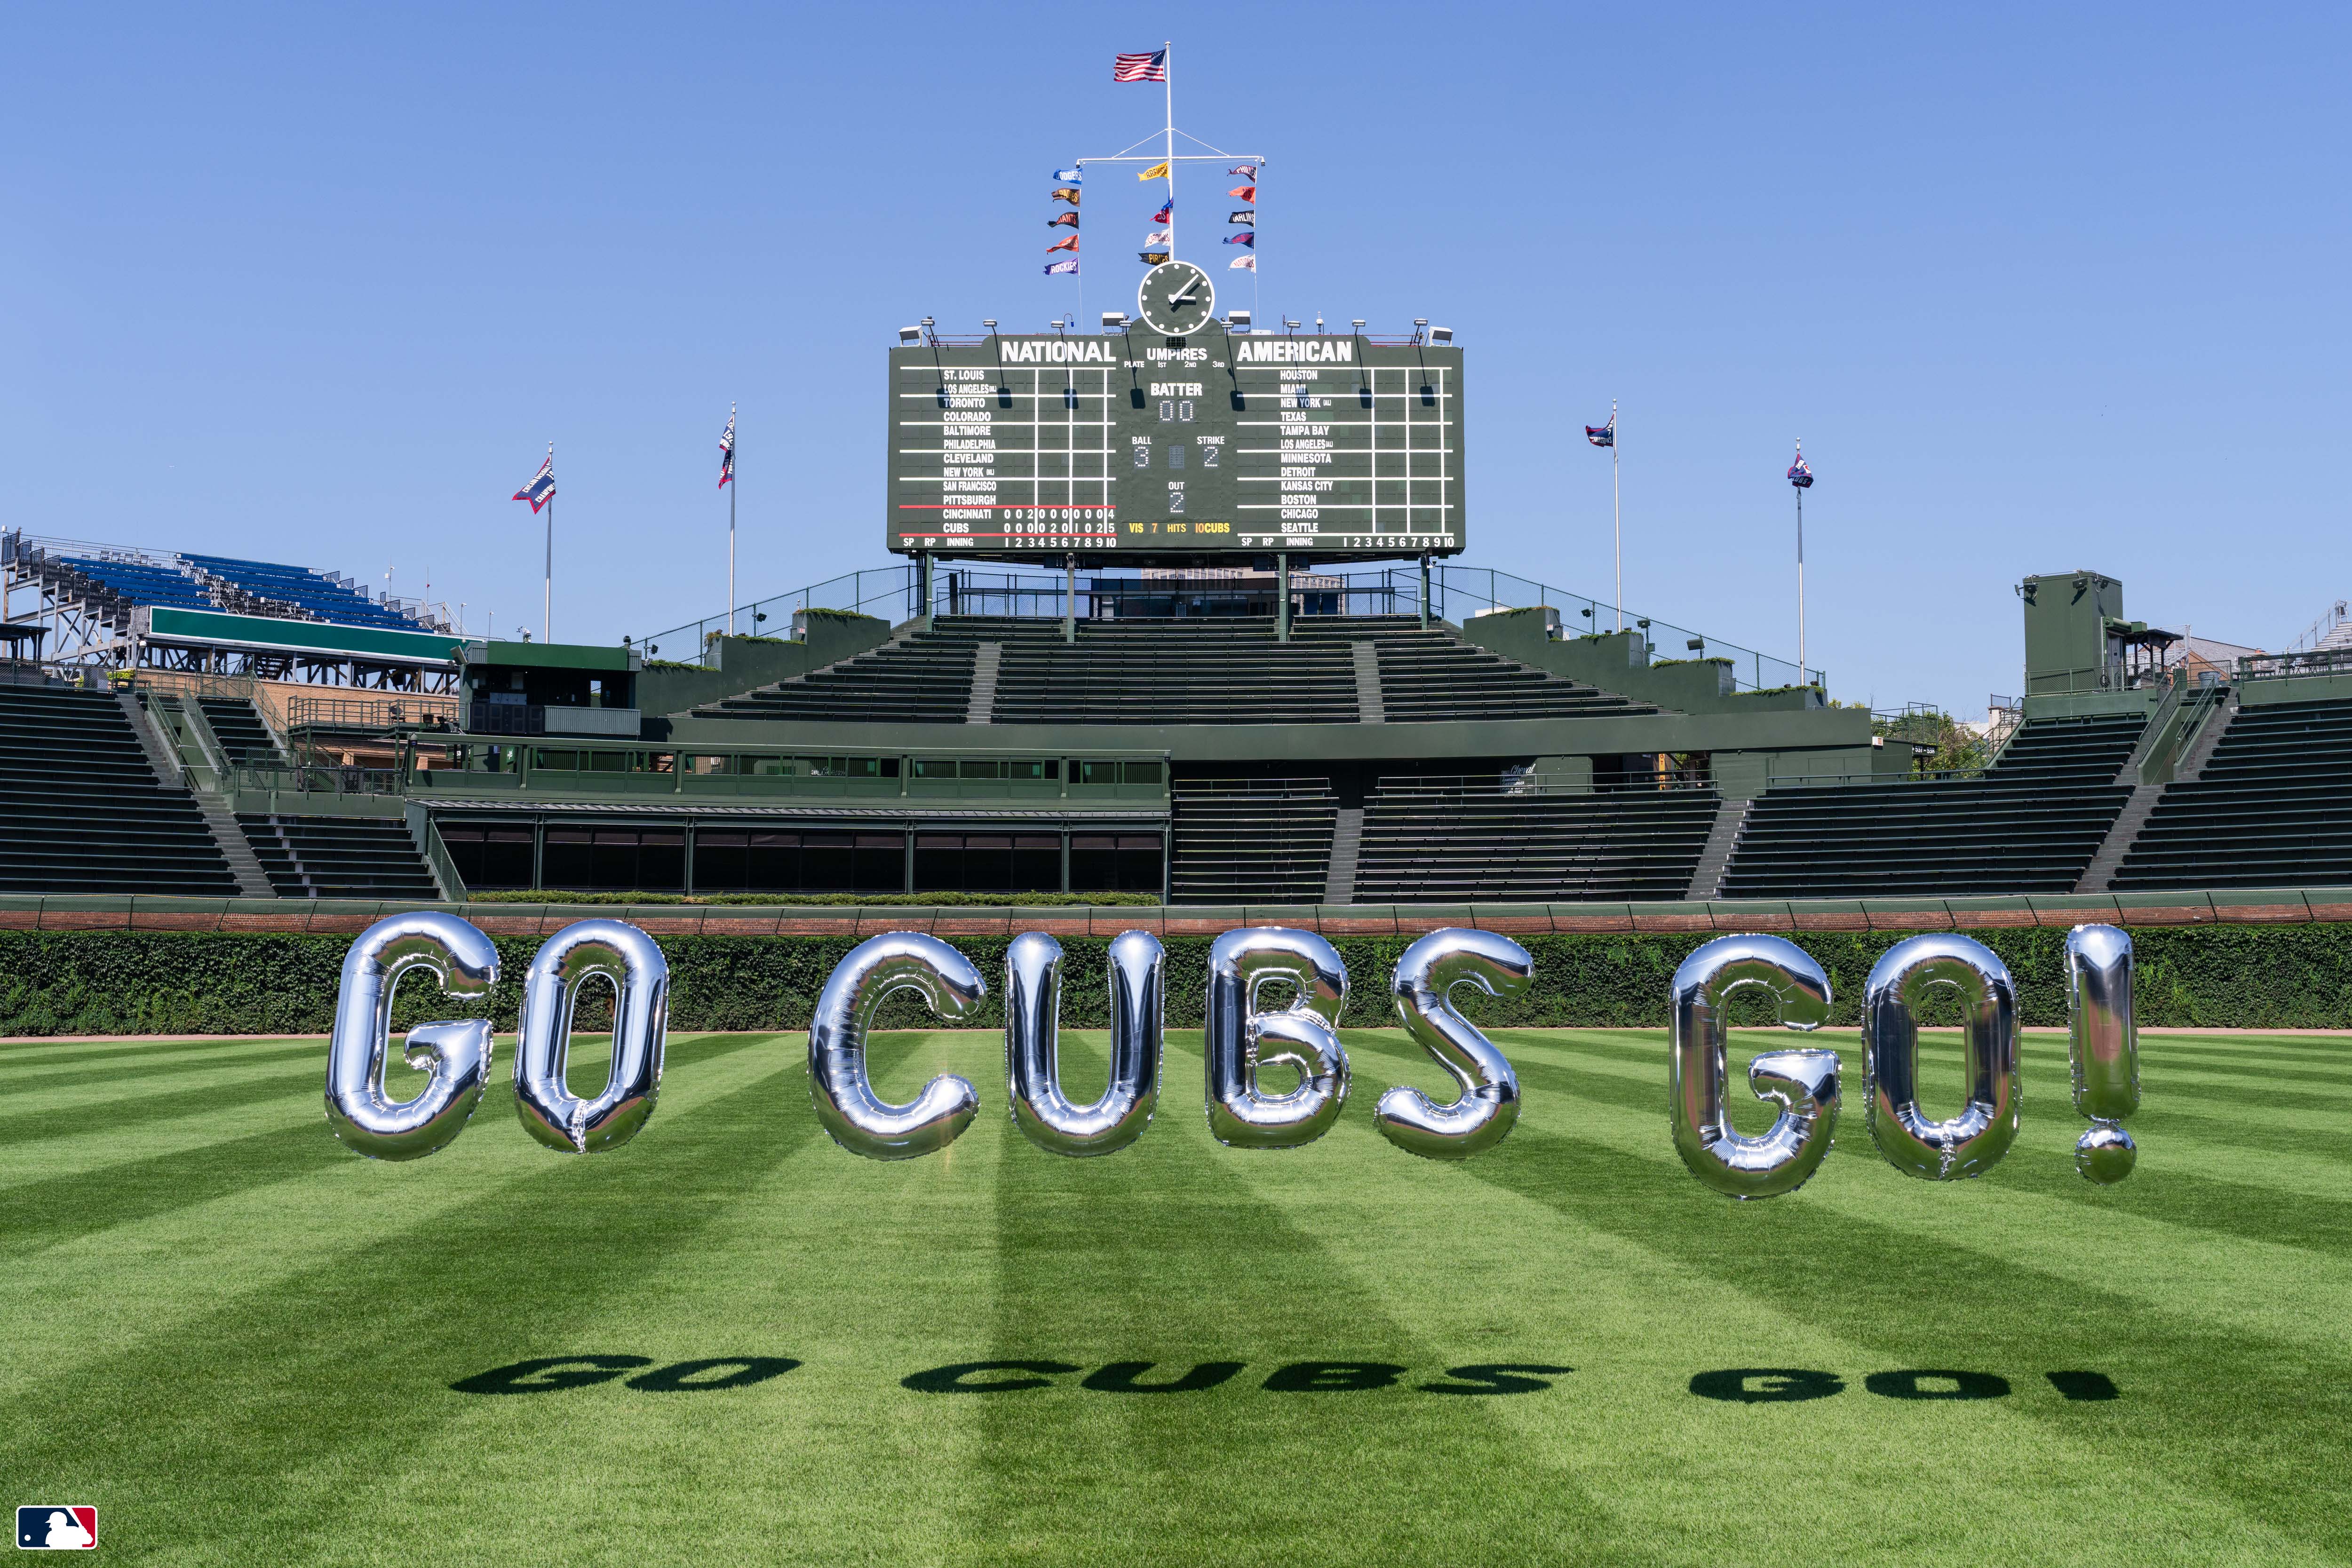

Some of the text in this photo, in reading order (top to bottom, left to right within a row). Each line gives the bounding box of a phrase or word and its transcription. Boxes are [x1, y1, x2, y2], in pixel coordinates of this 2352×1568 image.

[1059, 190, 1078, 202] PADES
[1051, 261, 1076, 274] ROCKIES
[1002, 341, 1116, 362] NATIONAL
[1147, 348, 1208, 360] UMPIRES
[1237, 341, 1351, 362] AMERICAN
[944, 370, 984, 380] ST. LOUIS
[1280, 370, 1317, 380] HOUSTON
[944, 384, 957, 394] LOS
[959, 384, 989, 394] ANGELES
[1151, 383, 1202, 396] BATTER
[1280, 384, 1306, 394] MIAMI
[944, 398, 985, 408] TORONTO
[1281, 398, 1297, 407] NEW
[1300, 398, 1321, 407] YORK
[943, 412, 992, 422] COLORADO
[1279, 412, 1307, 422] TEXAS
[944, 426, 991, 436] BALTIMORE
[1280, 426, 1329, 435] TAMPA BAY
[943, 439, 996, 450] PHILADELPHIA
[1197, 436, 1225, 444] STRIKE
[1280, 439, 1294, 450] LOS
[1295, 440, 1325, 449] ANGELES
[944, 453, 993, 463] CLEVELAND
[1135, 446, 1149, 467] 3
[1204, 446, 1218, 467] 2
[1281, 453, 1331, 463] MINNESOTA
[943, 467, 961, 478] NEW
[961, 467, 985, 478] YORK
[1280, 467, 1316, 478] DETROIT
[943, 481, 996, 491] SAN FRANCISCO
[1168, 482, 1185, 490] OUT
[1281, 481, 1333, 491] KANSAS CITY
[944, 495, 996, 505] PITTSBURGH
[1170, 492, 1184, 513] 2
[1280, 495, 1317, 506] BOSTON
[943, 509, 1114, 519] CINCINNATI 0 0 2 0 0 0 0 0 0 4
[1281, 509, 1318, 519] CHICAGO
[943, 523, 969, 533] CUBS
[1004, 523, 1010, 533] 0
[1016, 523, 1022, 533] 0
[1027, 523, 1033, 533] 0
[1039, 523, 1045, 533] 0
[1050, 523, 1057, 533] 2
[1062, 523, 1068, 533] 0
[1085, 523, 1091, 533] 0
[1097, 523, 1102, 533] 2
[1109, 523, 1114, 533] 5
[1129, 523, 1144, 533] VIS
[1152, 523, 1158, 533] 7
[1167, 524, 1186, 532] HITS
[1204, 523, 1230, 533] CUBS
[1280, 523, 1319, 534] SEATTLE
[1005, 538, 1009, 547] 1
[1016, 538, 1022, 547] 2
[1028, 538, 1035, 547] 3
[1038, 538, 1045, 547] 4
[1050, 538, 1057, 547] 5
[1062, 538, 1068, 547] 6
[1074, 538, 1080, 547] 7
[1085, 538, 1091, 547] 8
[1097, 538, 1103, 547] 9
[1106, 538, 1116, 547] 10
[1242, 538, 1252, 546] SP
[1344, 538, 1347, 547] 1
[1354, 538, 1360, 547] 2
[1365, 538, 1372, 547] 3
[1376, 537, 1383, 547] 4
[1389, 537, 1395, 547] 5
[1399, 537, 1406, 547] 6
[1411, 538, 1417, 547] 7
[1422, 538, 1430, 547] 8
[1434, 537, 1440, 547] 9
[1445, 537, 1454, 547] 10
[1510, 763, 1536, 775] Cheval
[325, 911, 2142, 1200] GO CUBS GO!
